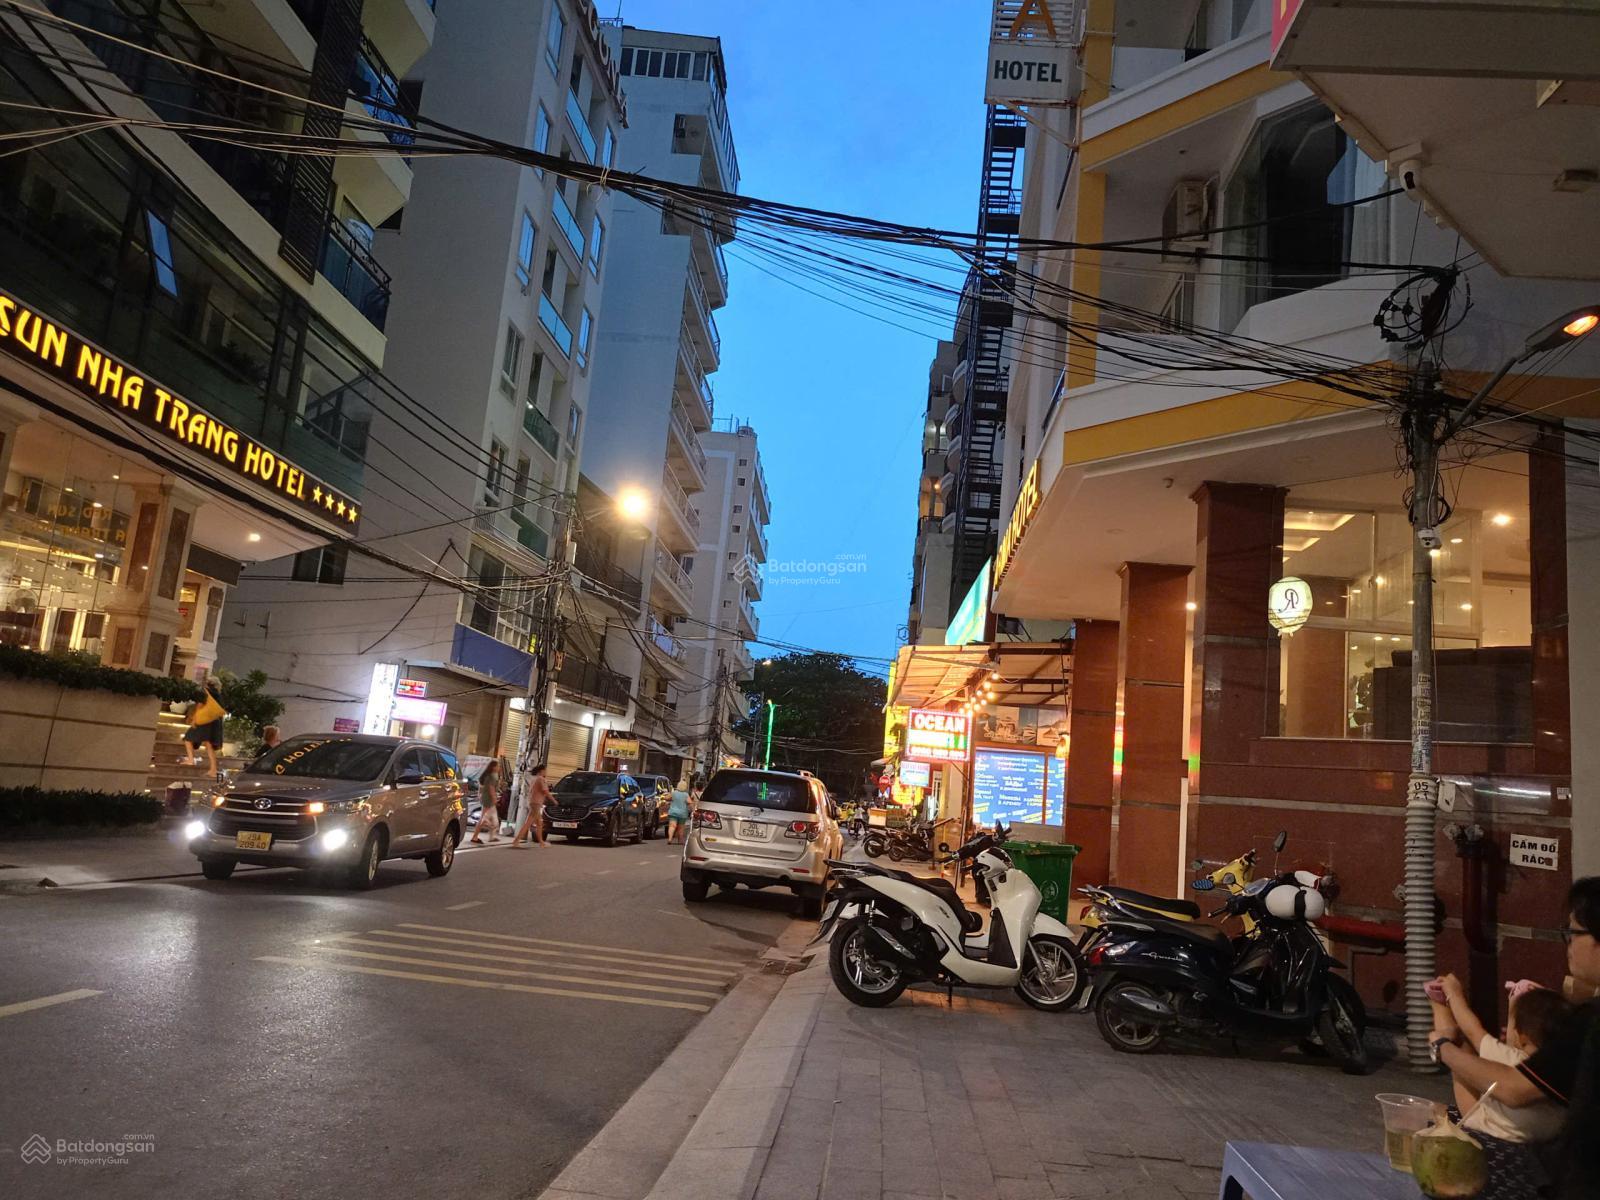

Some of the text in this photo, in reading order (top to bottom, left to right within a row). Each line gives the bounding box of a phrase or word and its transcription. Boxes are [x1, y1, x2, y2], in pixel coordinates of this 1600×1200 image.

[994, 60, 1062, 83] HOTEL
[0, 295, 305, 500] SUN NHA TRANG HOTEL
[914, 713, 966, 733] OCEAN
